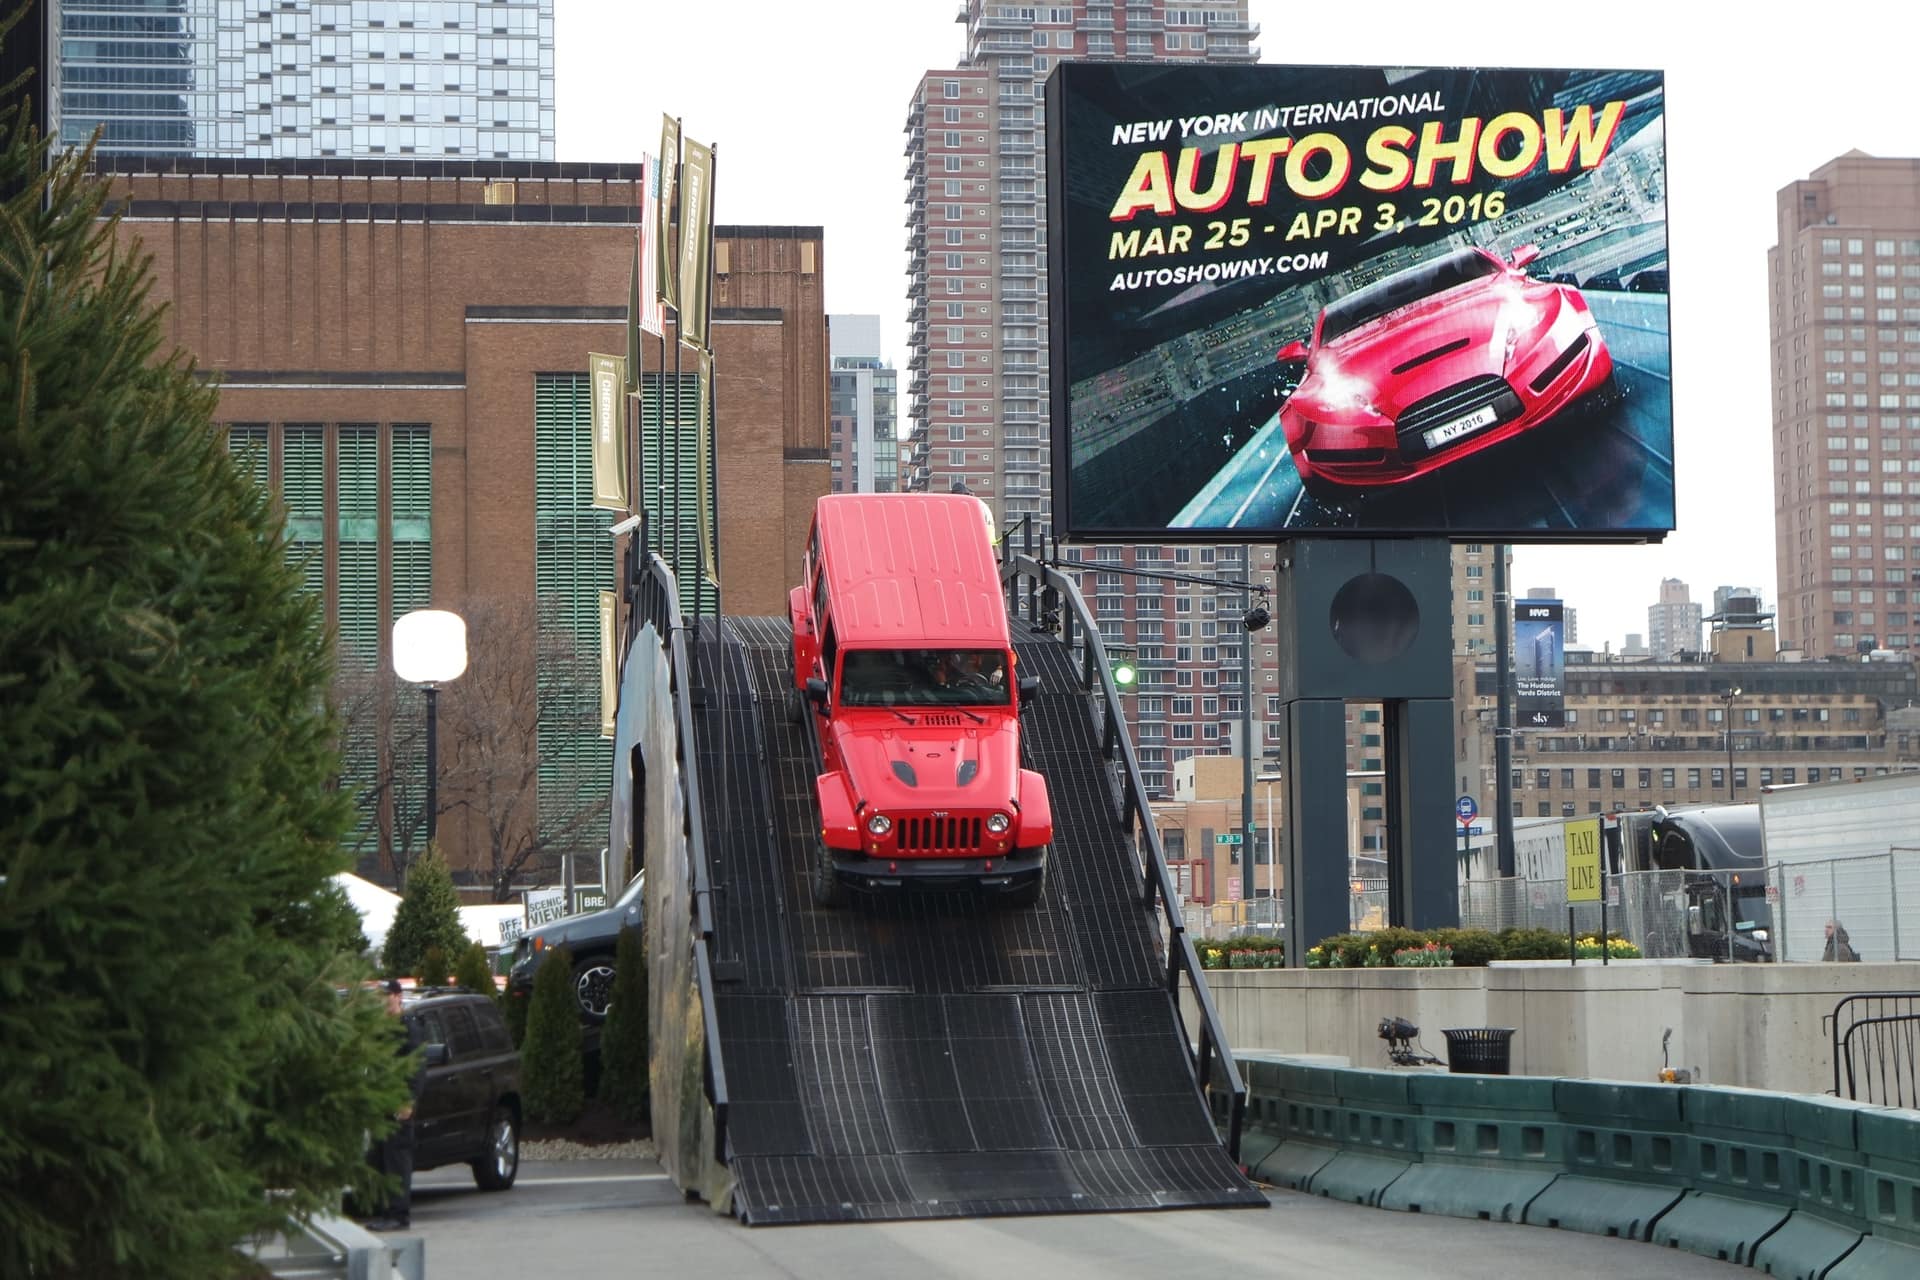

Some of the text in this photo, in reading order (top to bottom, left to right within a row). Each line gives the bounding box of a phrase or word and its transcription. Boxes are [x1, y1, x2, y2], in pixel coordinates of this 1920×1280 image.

[1112, 91, 1445, 145] NEW YORK INTERNATIONAL
[662, 147, 674, 199] GRAND
[1109, 101, 1627, 222] AUTO SHOW
[1108, 190, 1507, 260] MAR 25 - APR 3, 2016
[1109, 251, 1330, 292] AUTOSHOWNY.COM
[1443, 414, 1484, 437] NY 2016
[1529, 608, 1550, 617] NYC
[1532, 712, 1548, 726] sky
[1570, 831, 1594, 856] TAXI
[1571, 865, 1595, 890] LINE
[528, 907, 565, 926] VIEW
[529, 896, 562, 912] SCENIC
